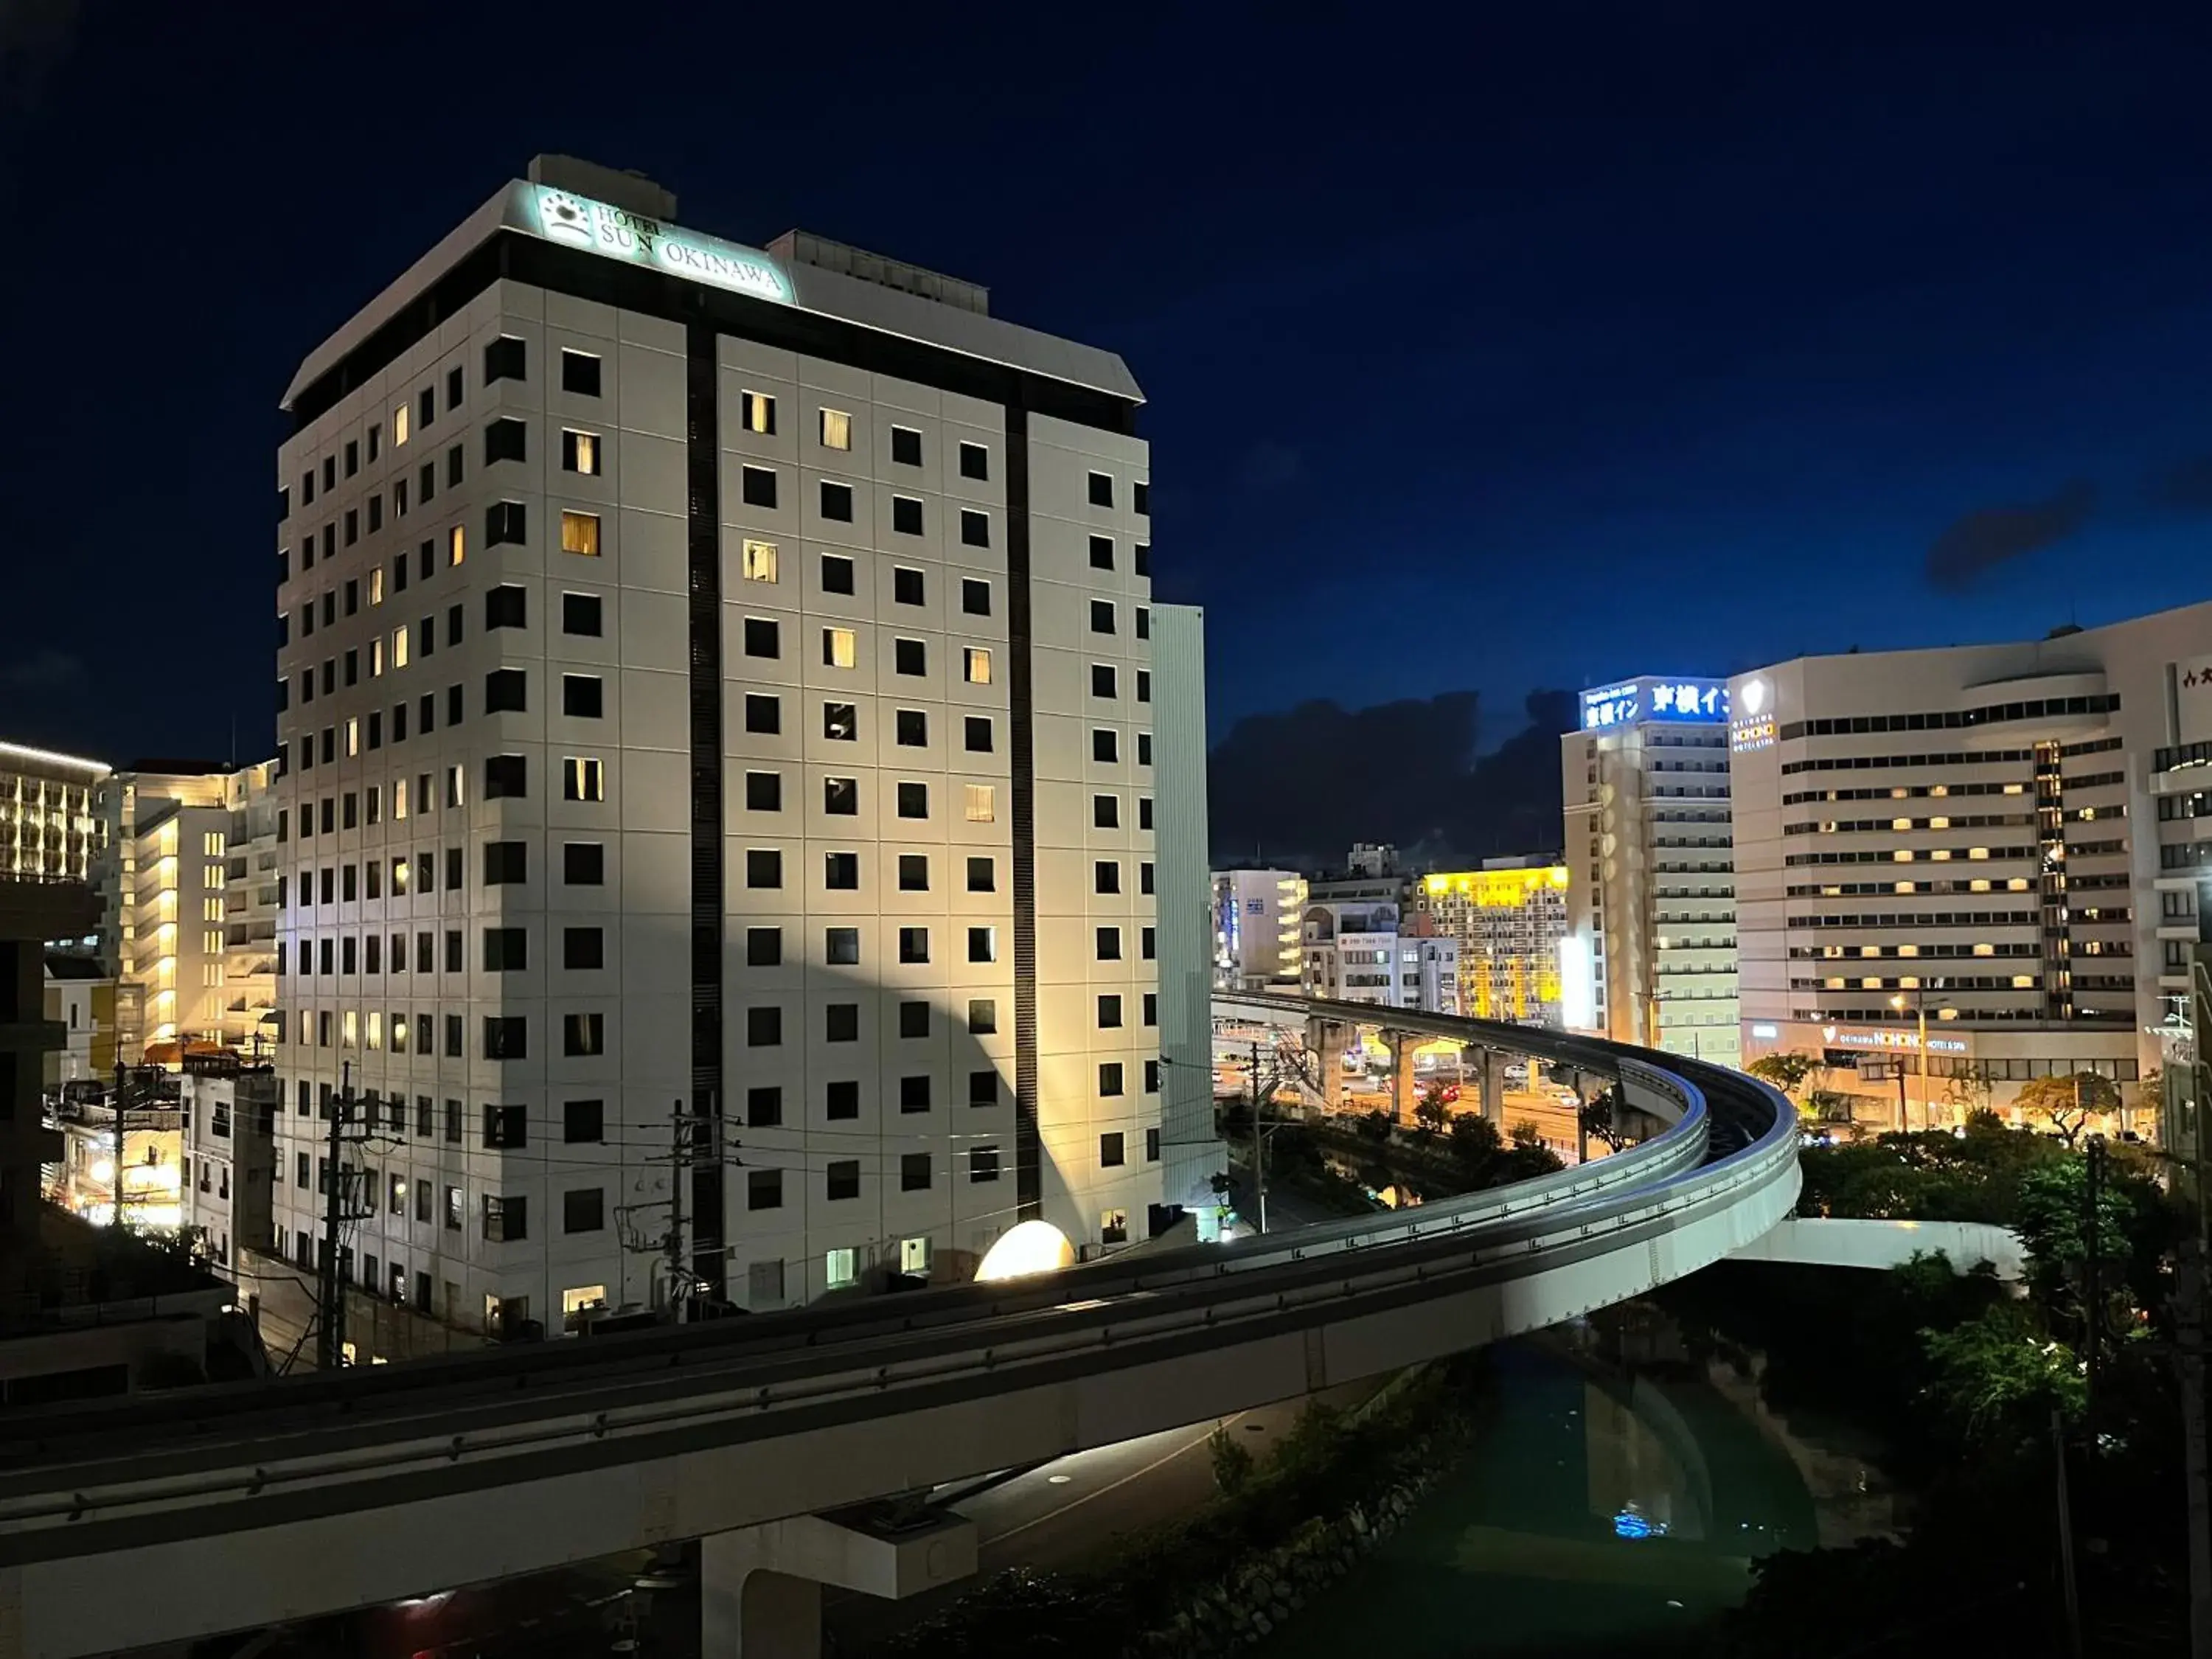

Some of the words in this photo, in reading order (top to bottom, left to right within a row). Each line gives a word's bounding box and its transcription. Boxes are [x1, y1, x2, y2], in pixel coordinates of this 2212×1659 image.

[597, 206, 664, 237] HOTEL
[600, 223, 654, 254] SUN
[666, 243, 782, 291] OKINAWA
